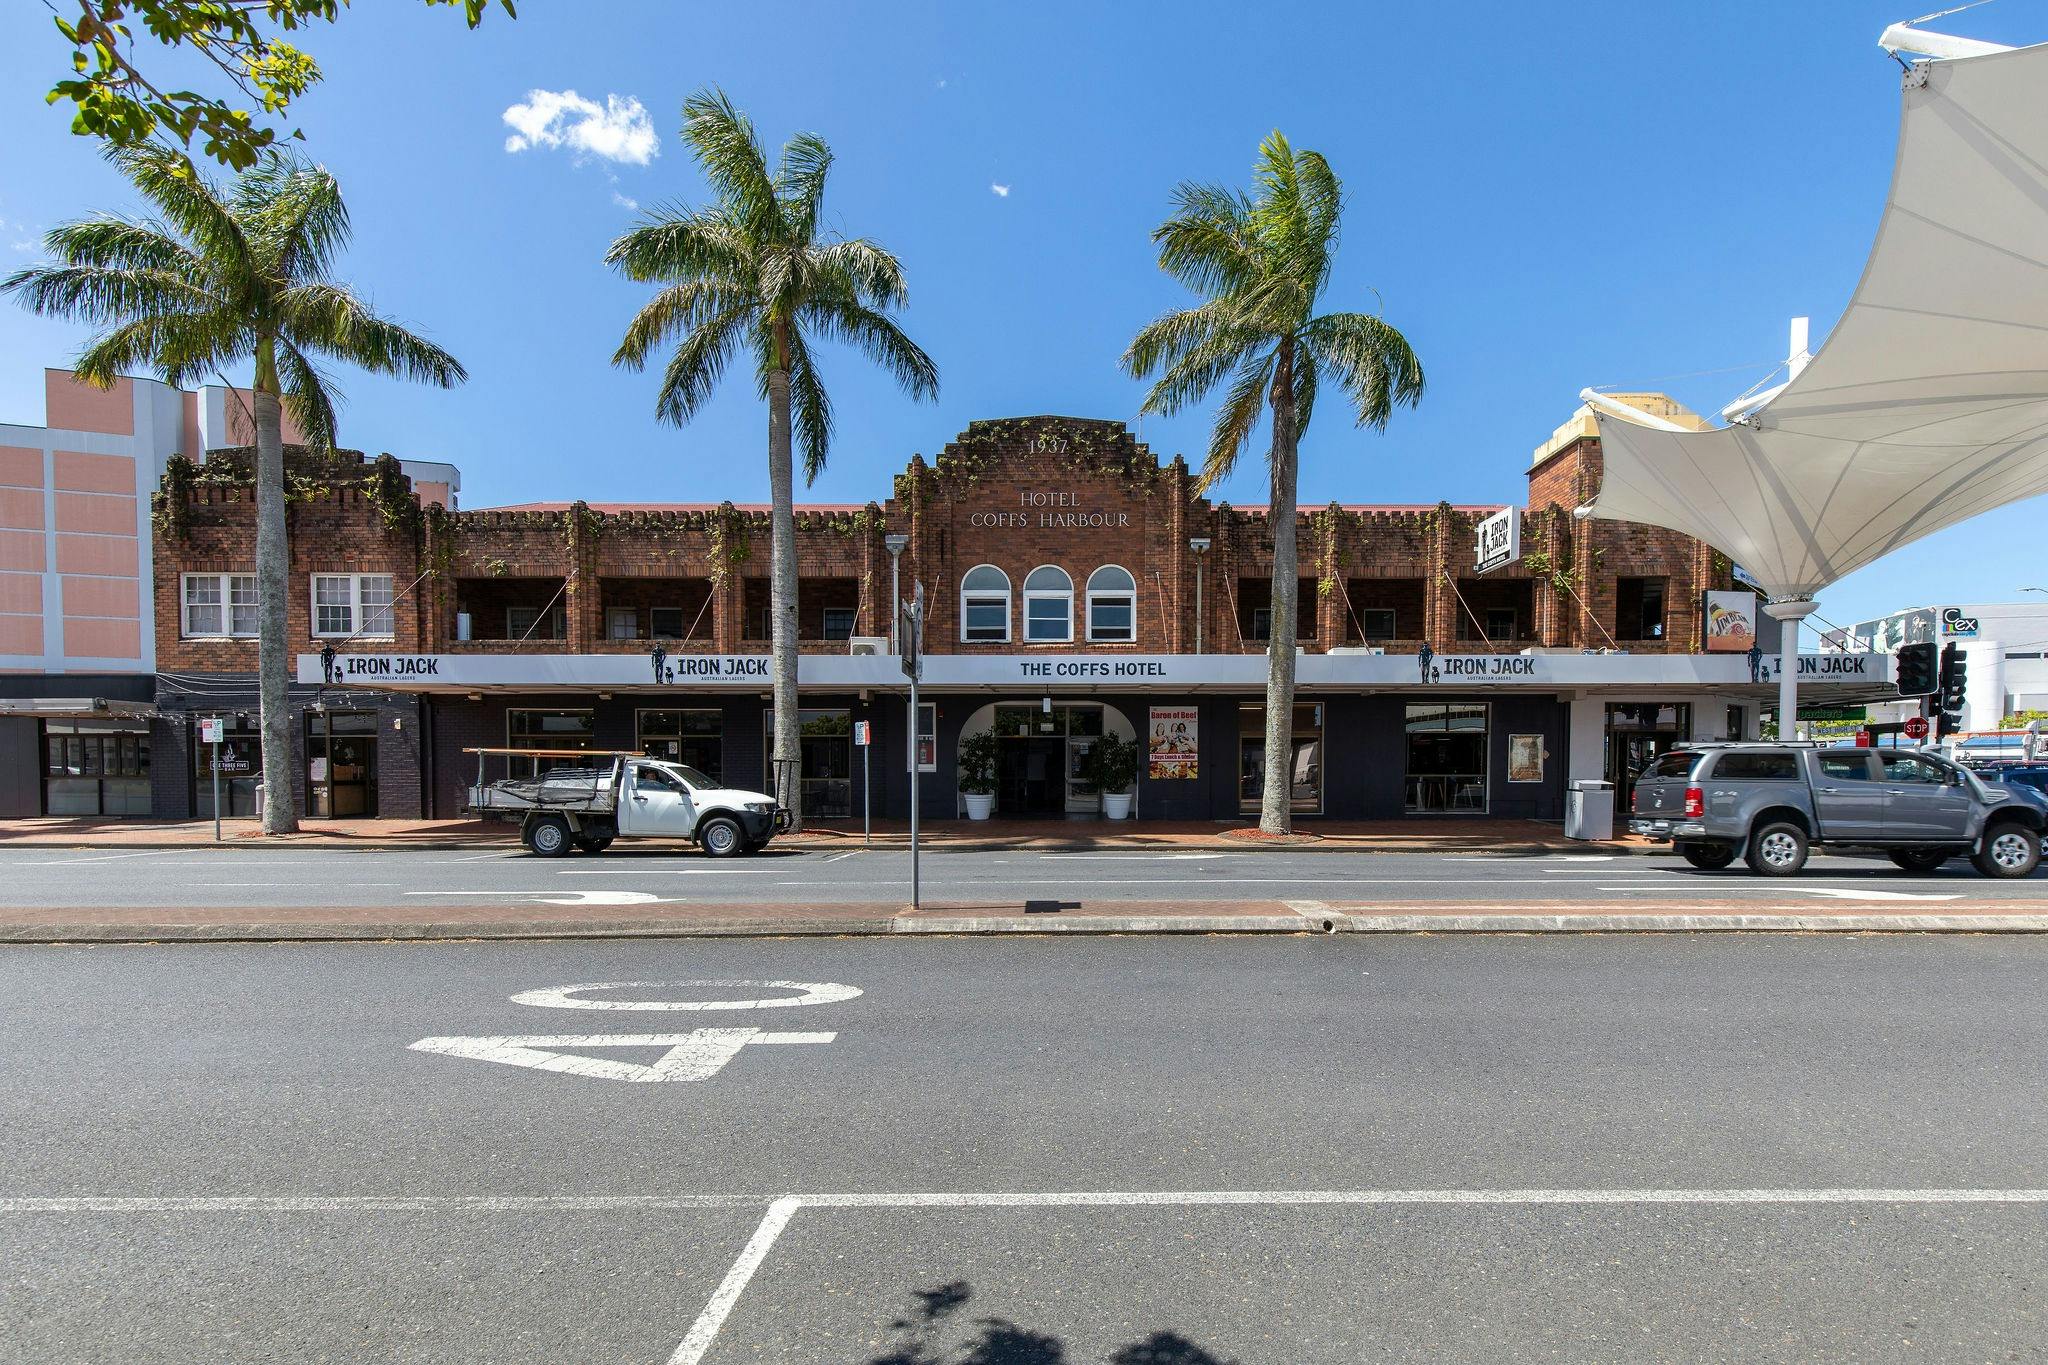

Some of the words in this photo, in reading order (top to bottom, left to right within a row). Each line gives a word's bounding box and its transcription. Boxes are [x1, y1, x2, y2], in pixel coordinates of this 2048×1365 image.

[1029, 439, 1068, 454] 1937
[1021, 492, 1081, 507] HOTEL
[971, 512, 1028, 527] COFFS
[1040, 512, 1130, 527] HARBOUR
[1491, 515, 1509, 538] IRON
[1490, 530, 1508, 552] JACK
[347, 658, 390, 675] IRON
[394, 658, 439, 675] JACK
[677, 658, 720, 675] IRON
[724, 658, 768, 675] JACK
[1020, 663, 1052, 676] THE
[1056, 662, 1110, 676] COFFS
[1115, 662, 1167, 676] HOTEL
[1443, 658, 1487, 675] IRON
[1491, 658, 1535, 675] JACK
[1773, 657, 1817, 673] ION
[1821, 657, 1865, 674] JACK
[1151, 711, 1172, 719] Baron
[1172, 711, 1180, 719] of
[1181, 711, 1197, 719] Beef
[1906, 724, 1928, 733] STOP
[406, 979, 865, 1083] 40
